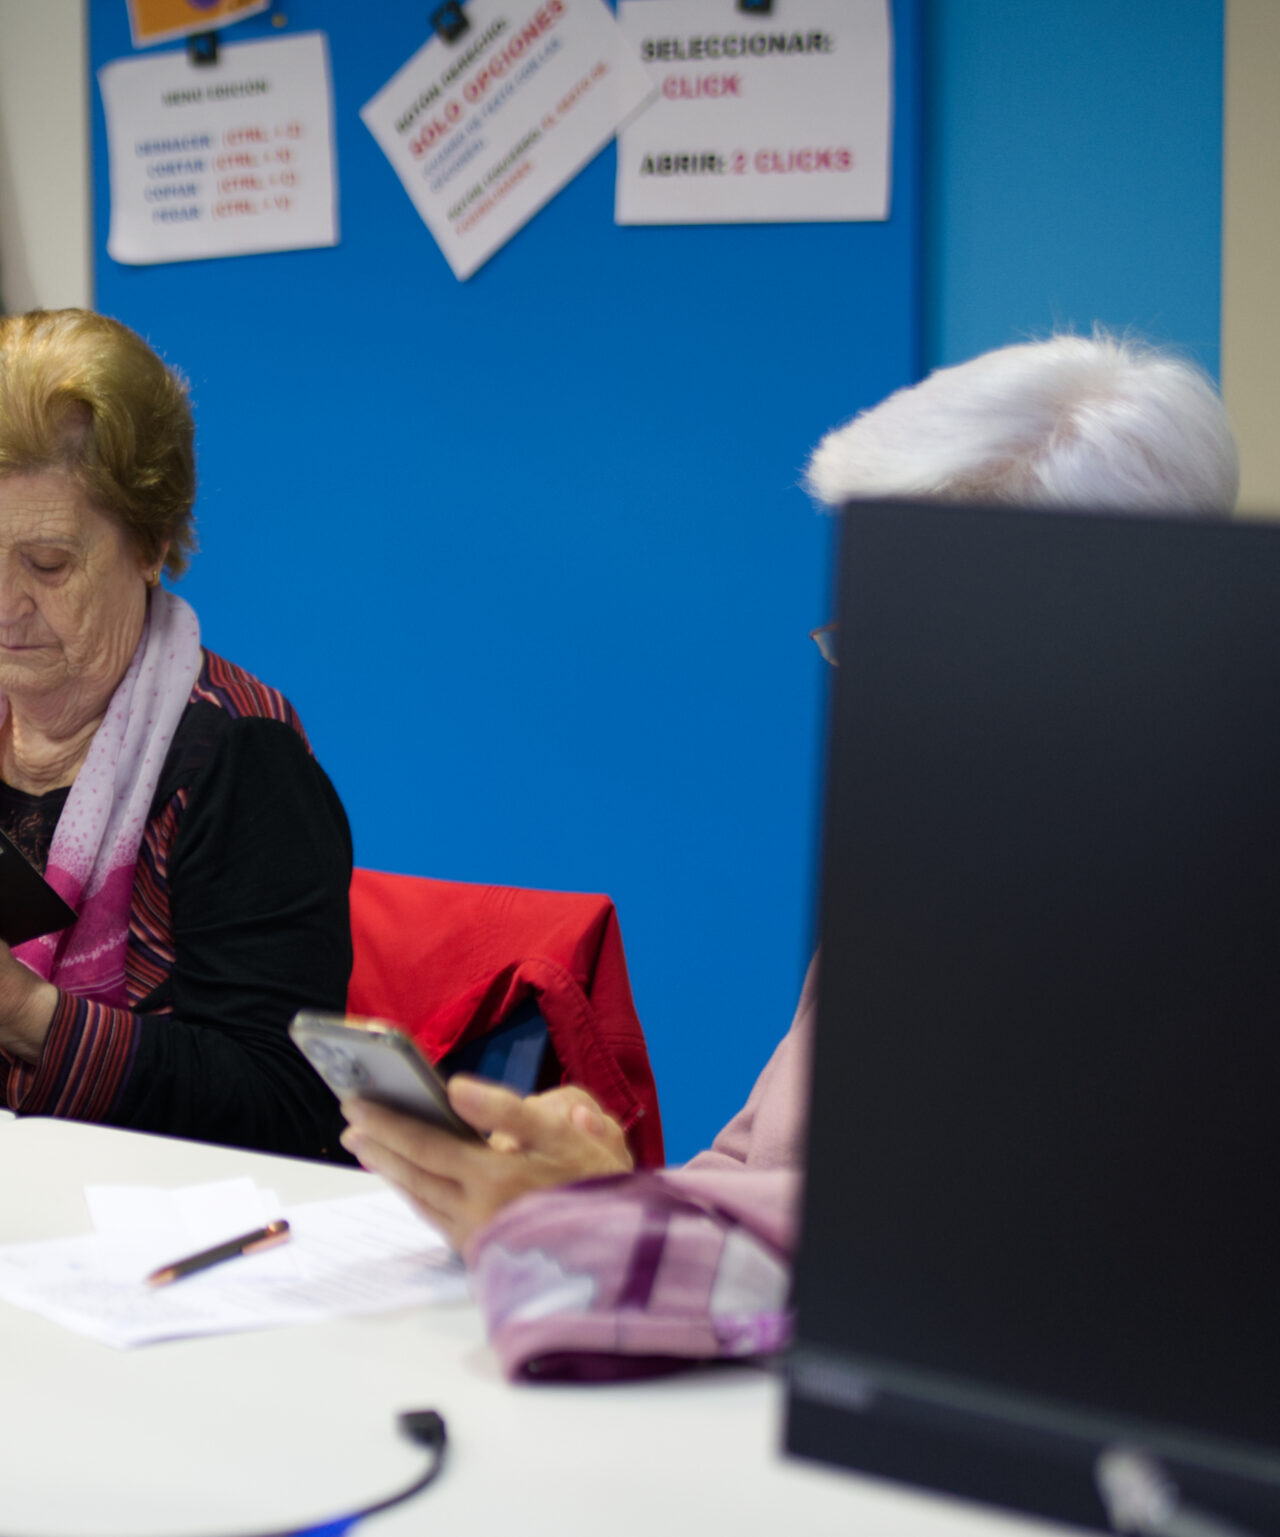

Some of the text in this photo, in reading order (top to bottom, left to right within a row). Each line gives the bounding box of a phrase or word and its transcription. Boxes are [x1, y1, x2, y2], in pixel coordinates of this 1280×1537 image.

[640, 32, 834, 63] SELECCIONAR:
[408, 0, 567, 160] SOLO OPCIONES
[661, 73, 743, 101] CLICK
[640, 146, 853, 176] ABRIR: 2 CLICKS
